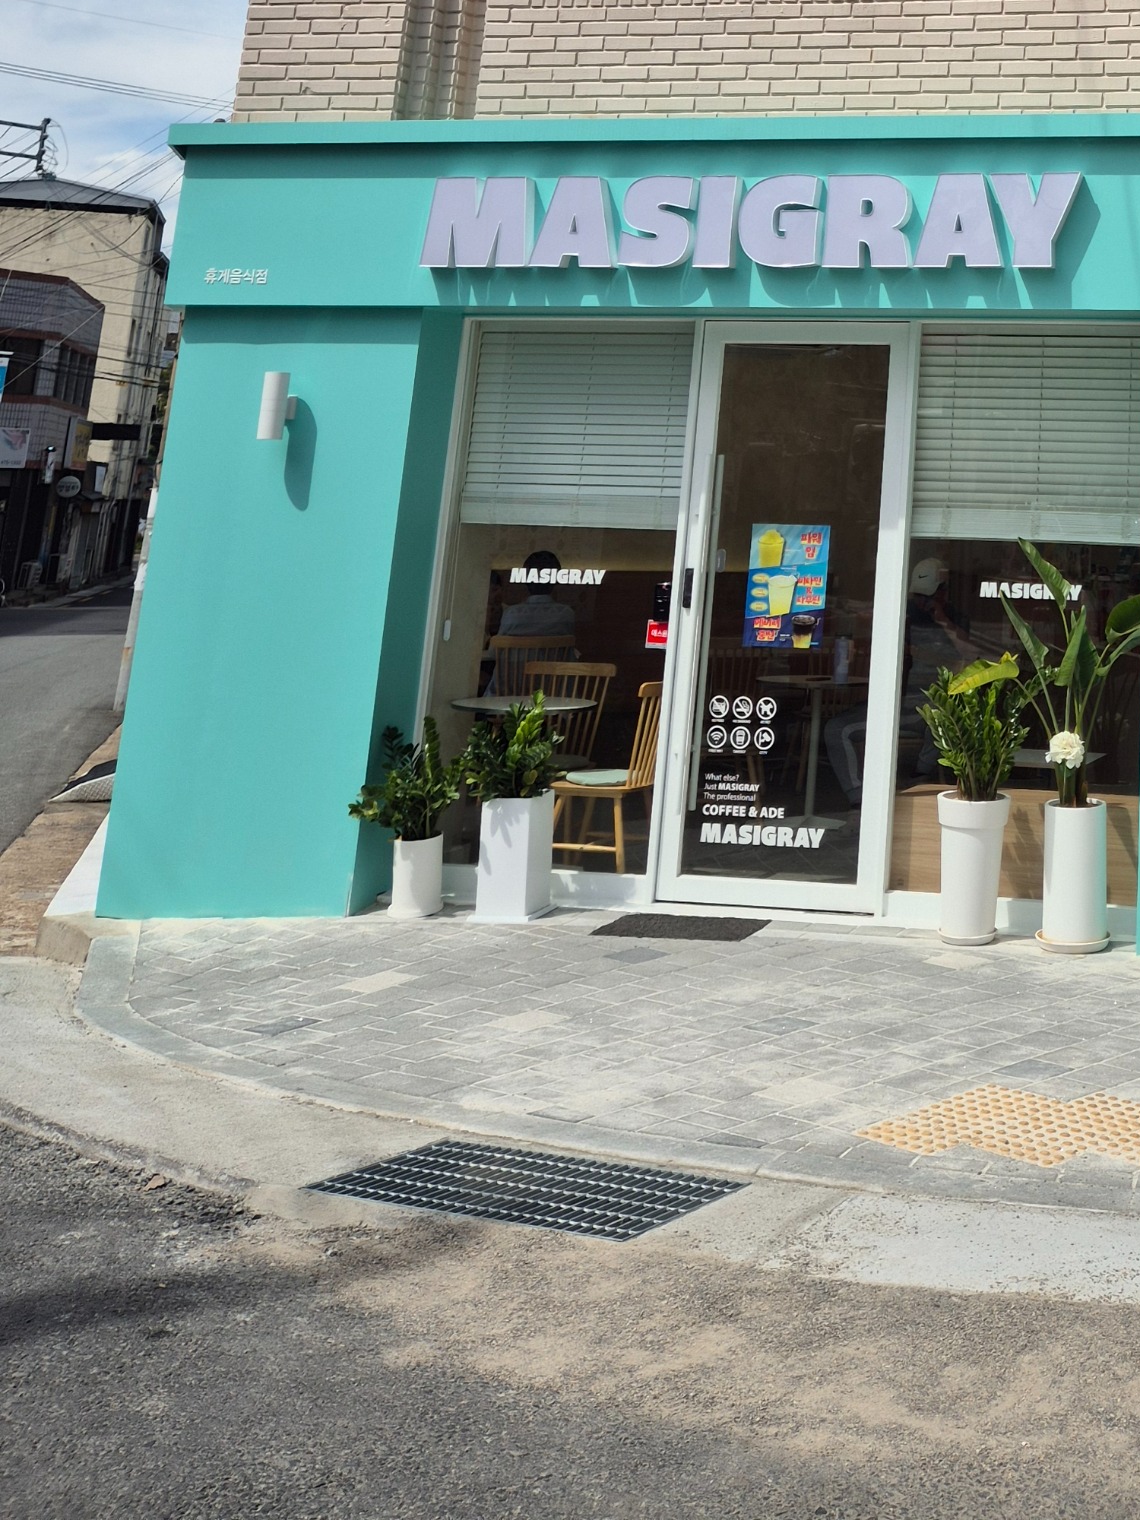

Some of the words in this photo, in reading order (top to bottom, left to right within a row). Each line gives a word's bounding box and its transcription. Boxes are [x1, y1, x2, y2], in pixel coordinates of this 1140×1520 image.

[420, 173, 1085, 270] MASIGRAY
[204, 267, 268, 285] 휴게음식점
[509, 567, 607, 585] MASIGRAY
[979, 581, 1083, 601] MASIGRY
[704, 773, 722, 781] What
[723, 774, 740, 782] else?
[703, 782, 717, 791] Just
[718, 783, 760, 792] MASIGRAY
[703, 792, 715, 800] The
[716, 793, 757, 802] professional
[702, 804, 747, 818] COFFEE
[748, 806, 758, 818] &
[760, 807, 785, 819] ADE
[700, 822, 826, 849] MASIGRAY
